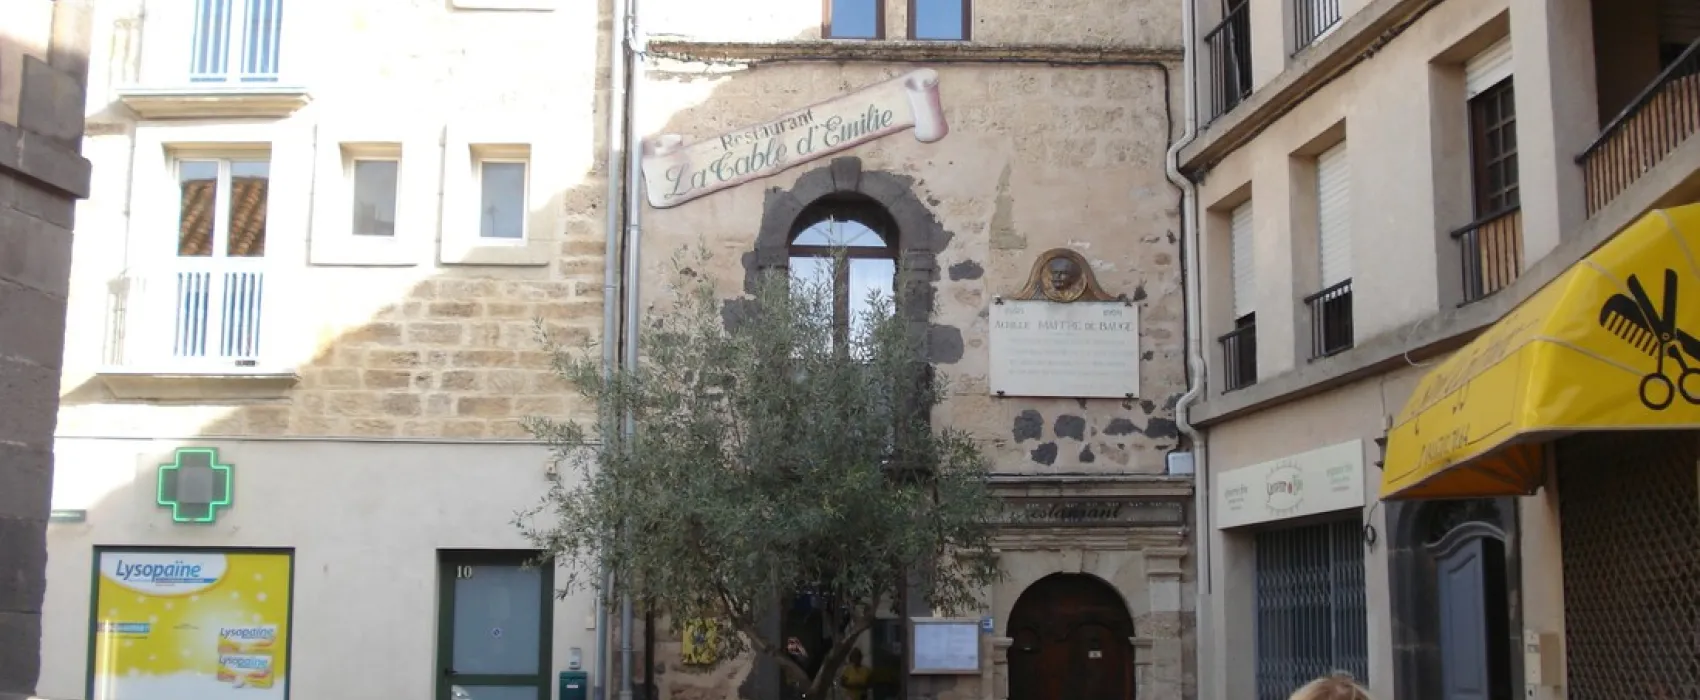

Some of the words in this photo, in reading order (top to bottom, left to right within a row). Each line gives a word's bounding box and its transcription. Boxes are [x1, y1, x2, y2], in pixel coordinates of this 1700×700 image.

[719, 109, 815, 150] Restaurant
[663, 161, 707, 199] La
[115, 559, 202, 583] Lysopaïne
[456, 565, 472, 578] 10
